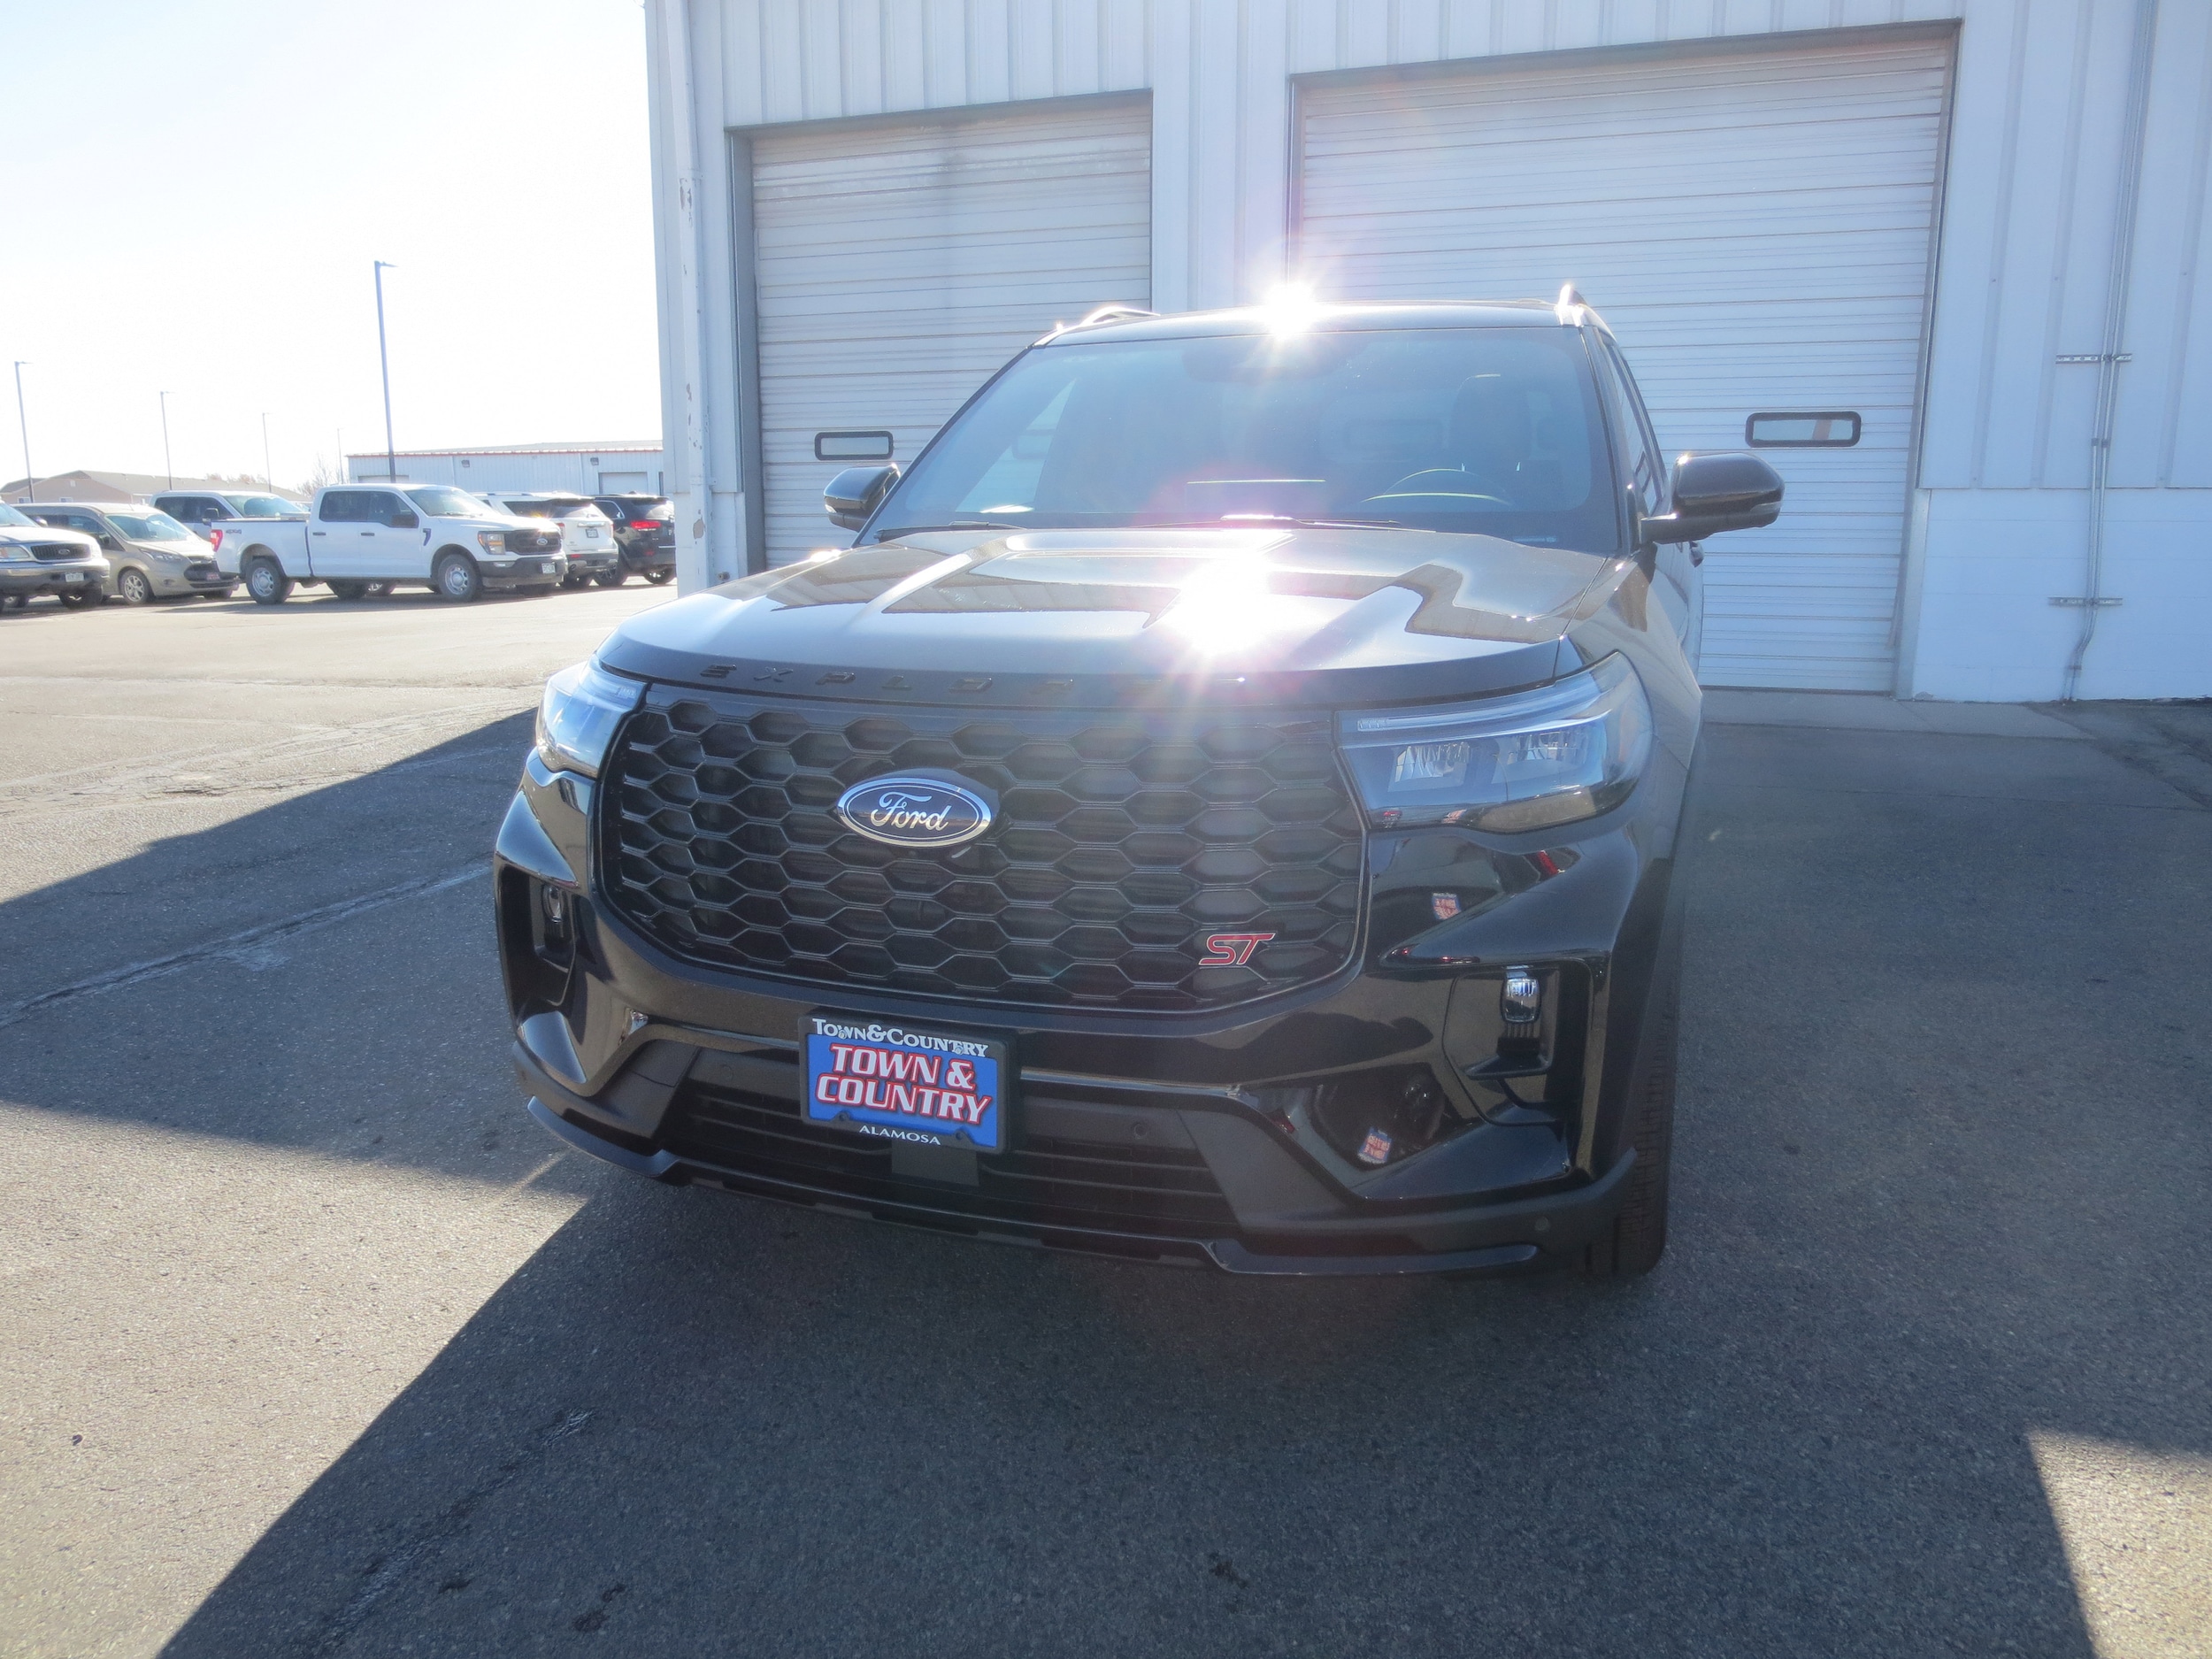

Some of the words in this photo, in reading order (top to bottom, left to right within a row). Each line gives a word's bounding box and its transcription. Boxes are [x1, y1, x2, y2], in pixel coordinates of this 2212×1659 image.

[699, 663, 1246, 695] EXPLOR
[870, 791, 952, 832] Ford
[1198, 933, 1276, 965] ST
[830, 1043, 941, 1086] TOWN
[946, 1058, 975, 1091] &
[816, 1072, 992, 1125] COUNTRY
[859, 1125, 941, 1146] ALAMOSA
